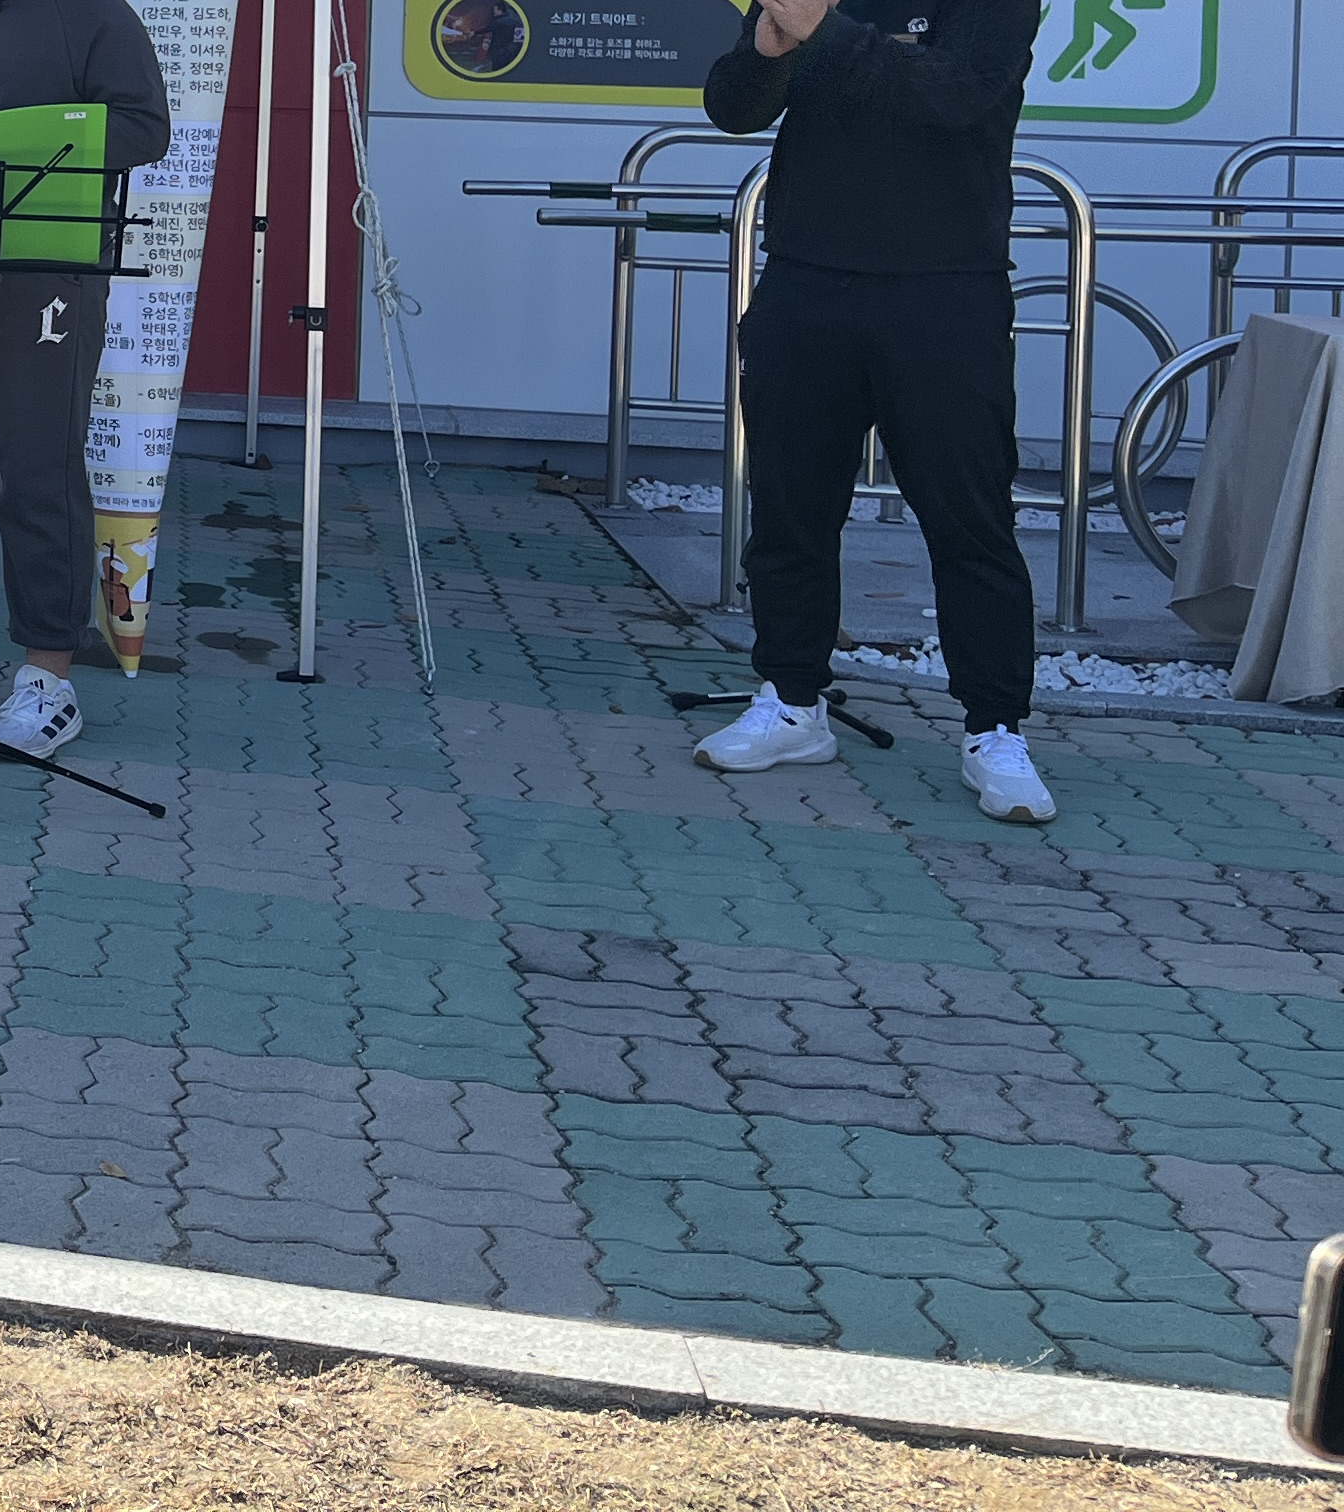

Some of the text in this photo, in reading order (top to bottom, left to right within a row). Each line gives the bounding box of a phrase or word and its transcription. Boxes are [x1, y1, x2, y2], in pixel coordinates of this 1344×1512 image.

[141, 7, 231, 22] (강은채, 김도하,
[550, 12, 586, 25] 소화기
[589, 13, 638, 26] 트릭아트
[190, 25, 229, 40] 박서우,
[153, 43, 228, 59] 채윤, 이서우,
[189, 61, 227, 77] 정연우,
[143, 174, 184, 189] 장소은,
[142, 232, 185, 247] 정현주)
[141, 307, 181, 323] 유성은,
[141, 322, 181, 338] 박태우,
[103, 336, 135, 351] 인들)
[141, 337, 180, 353] 우형민,
[140, 353, 180, 368] 차가영)
